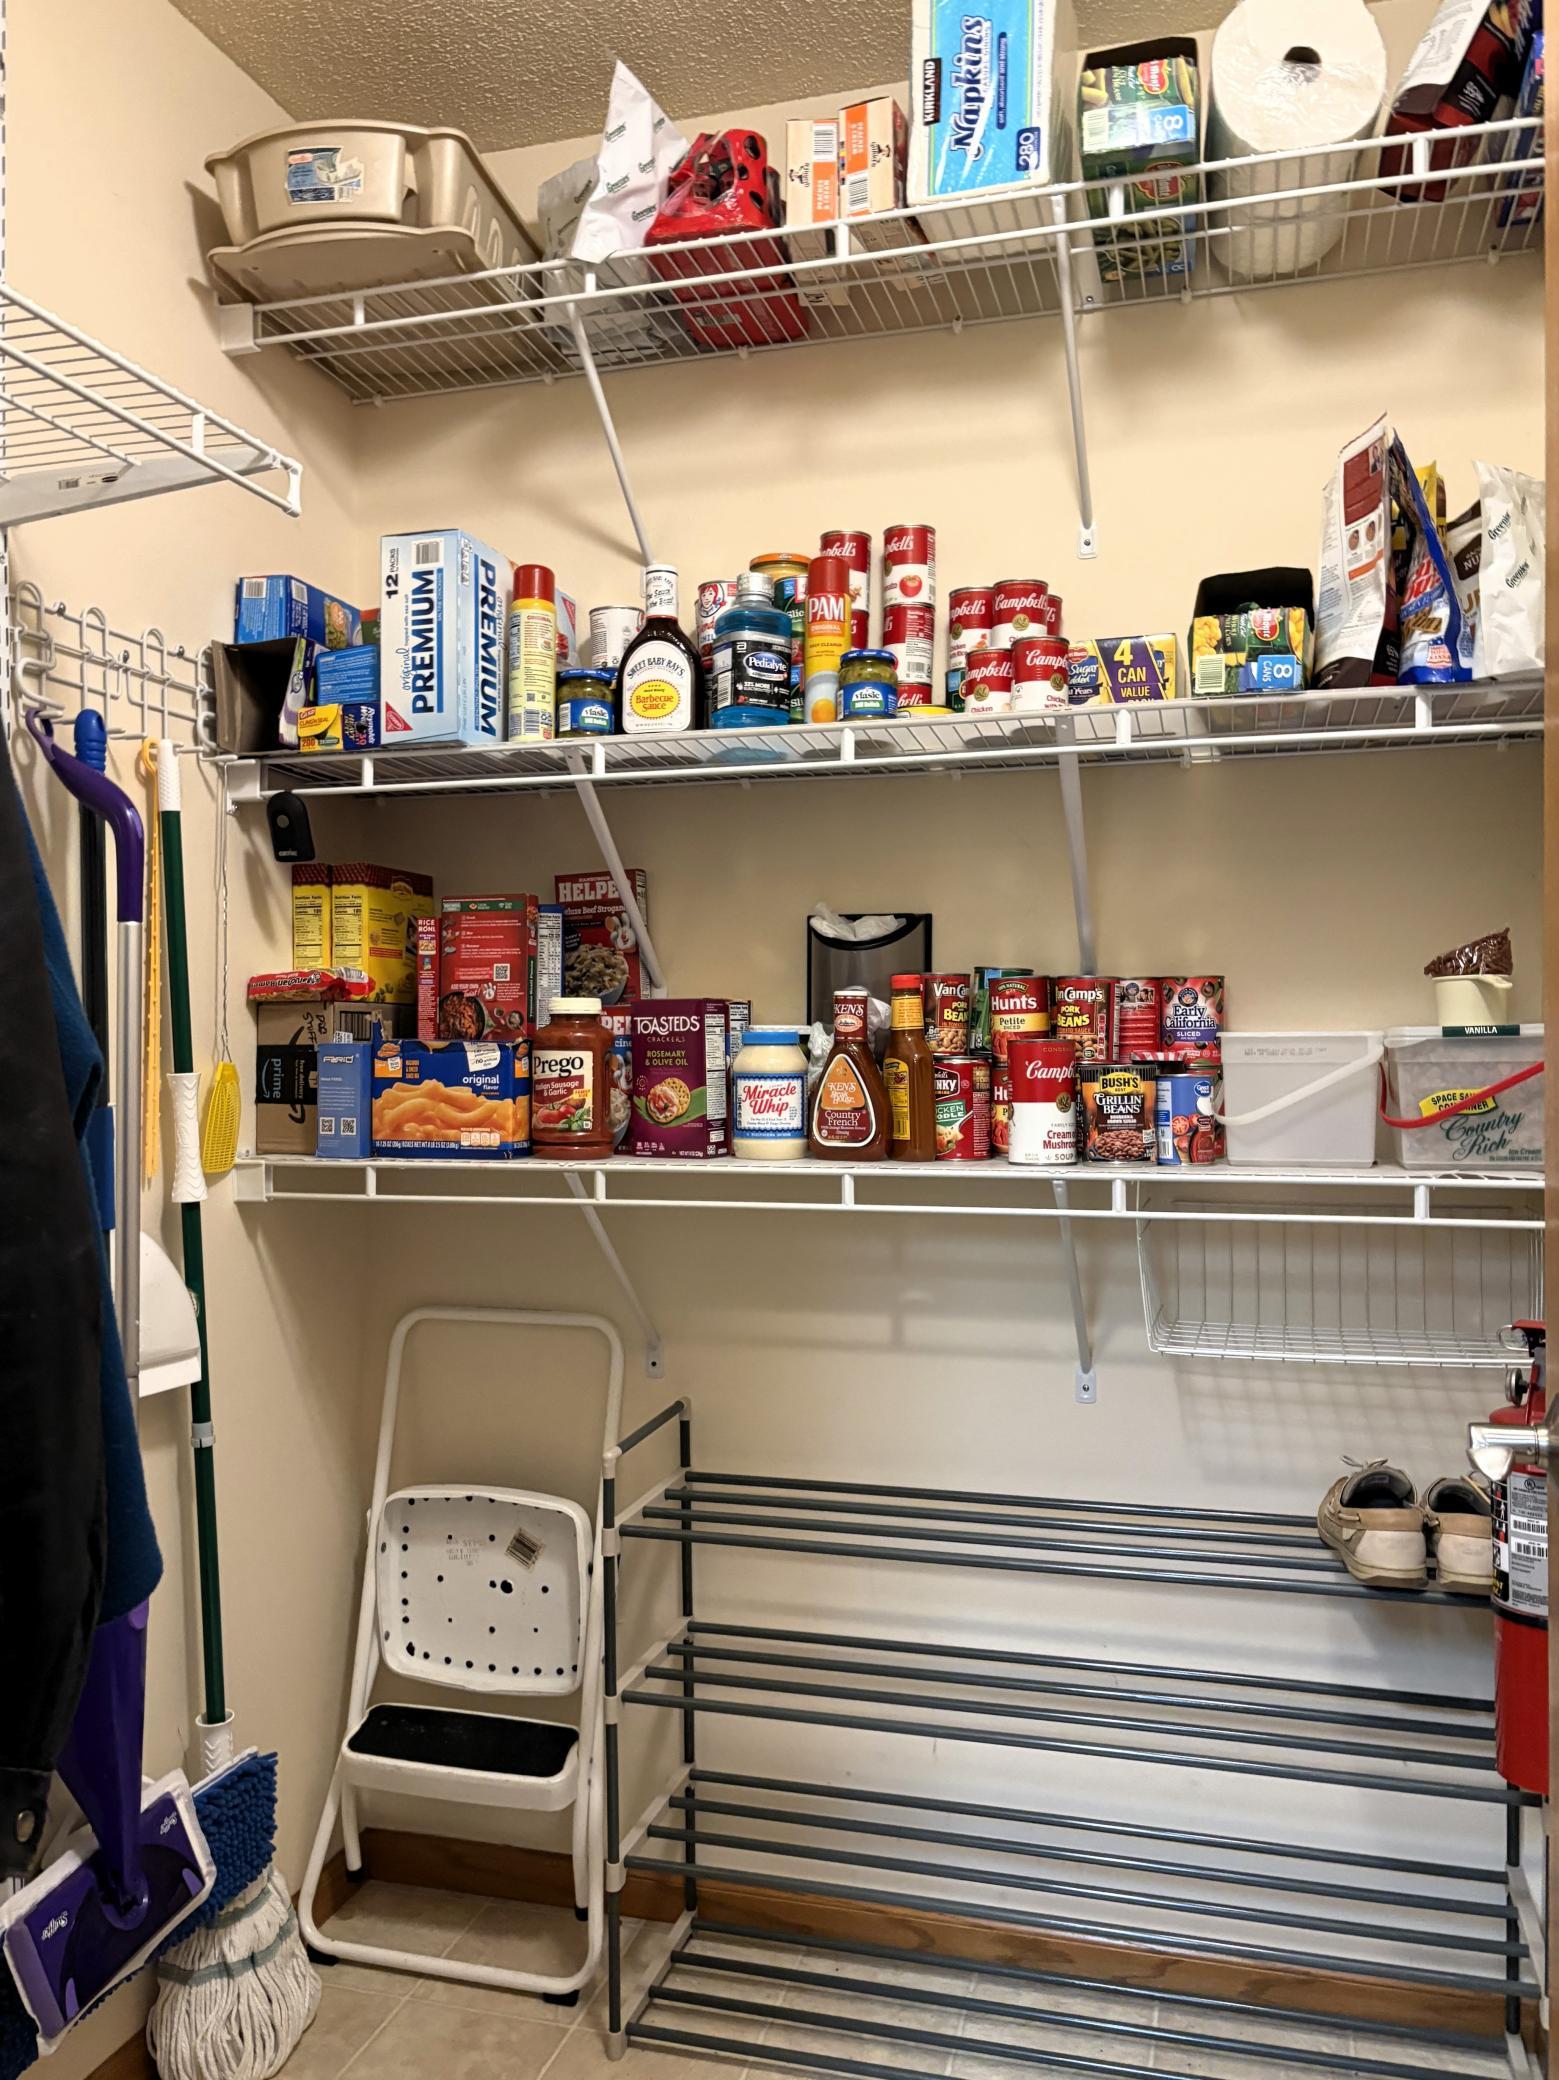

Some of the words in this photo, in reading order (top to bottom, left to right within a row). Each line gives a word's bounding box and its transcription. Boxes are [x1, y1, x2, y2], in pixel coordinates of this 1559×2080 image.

[924, 60, 936, 122] KIRKLAND
[950, 15, 985, 161] Napkins
[1164, 114, 1184, 130] 8
[1019, 132, 1035, 166] 280
[823, 542, 856, 556] bell's
[887, 536, 914, 552] bell's
[386, 573, 398, 599] 12
[808, 594, 844, 622] PAM
[951, 600, 986, 616] mpbell's
[995, 593, 1048, 611] Campbell's
[788, 608, 804, 618] Slic
[412, 570, 434, 714] PREMIUM
[480, 558, 497, 737] PREMIUM
[1026, 649, 1068, 670] Campb
[1114, 639, 1134, 666] 4
[396, 648, 414, 691] original
[626, 660, 646, 680] SWEET
[647, 657, 666, 667] BABY
[666, 660, 686, 678] RAY'S
[748, 656, 787, 672] Pedialyte
[1070, 664, 1098, 676] Sugar
[1262, 660, 1272, 682] CANS
[1274, 664, 1293, 678] 8
[1118, 666, 1146, 683] CAN
[636, 694, 674, 704] Barbecue
[1120, 686, 1151, 698] VALUE
[642, 703, 667, 712] Sauce
[558, 881, 620, 902] HELPE
[598, 905, 626, 914] Strogan
[934, 983, 956, 998] Van
[1064, 987, 1102, 1002] Camp's
[834, 1004, 864, 1016] KEN'S
[1061, 1006, 1080, 1014] PORK
[1173, 1005, 1207, 1018] Early
[634, 1016, 700, 1036] TOASTEDS
[1000, 1017, 1026, 1026] Petite
[1057, 1014, 1090, 1027] BEANS
[1165, 1016, 1216, 1030] California
[1464, 1026, 1498, 1034] VANILLA
[646, 1050, 686, 1058] ROSEMARY
[534, 1056, 584, 1078] Prego
[652, 1058, 674, 1066] OLIVE
[675, 1058, 688, 1066] OIL
[271, 1058, 284, 1098] prime
[1025, 1060, 1075, 1082] Campb
[462, 1074, 500, 1086] original
[828, 1082, 856, 1092] KEN'S
[936, 1080, 957, 1092] NKY
[1102, 1076, 1138, 1089] BUSH'S
[742, 1082, 797, 1102] Miracle
[1432, 1092, 1457, 1105] SPACE
[1094, 1093, 1144, 1106] GRILLIN'
[750, 1098, 789, 1118] Whip
[824, 1110, 861, 1120] Country
[936, 1105, 964, 1114] CKEN
[1104, 1104, 1140, 1114] BEANS
[828, 1118, 858, 1126] French
[936, 1112, 964, 1120] ODLE
[1440, 1108, 1524, 1142] Country
[1047, 1130, 1072, 1140] Cream
[1452, 1131, 1512, 1161] Rich
